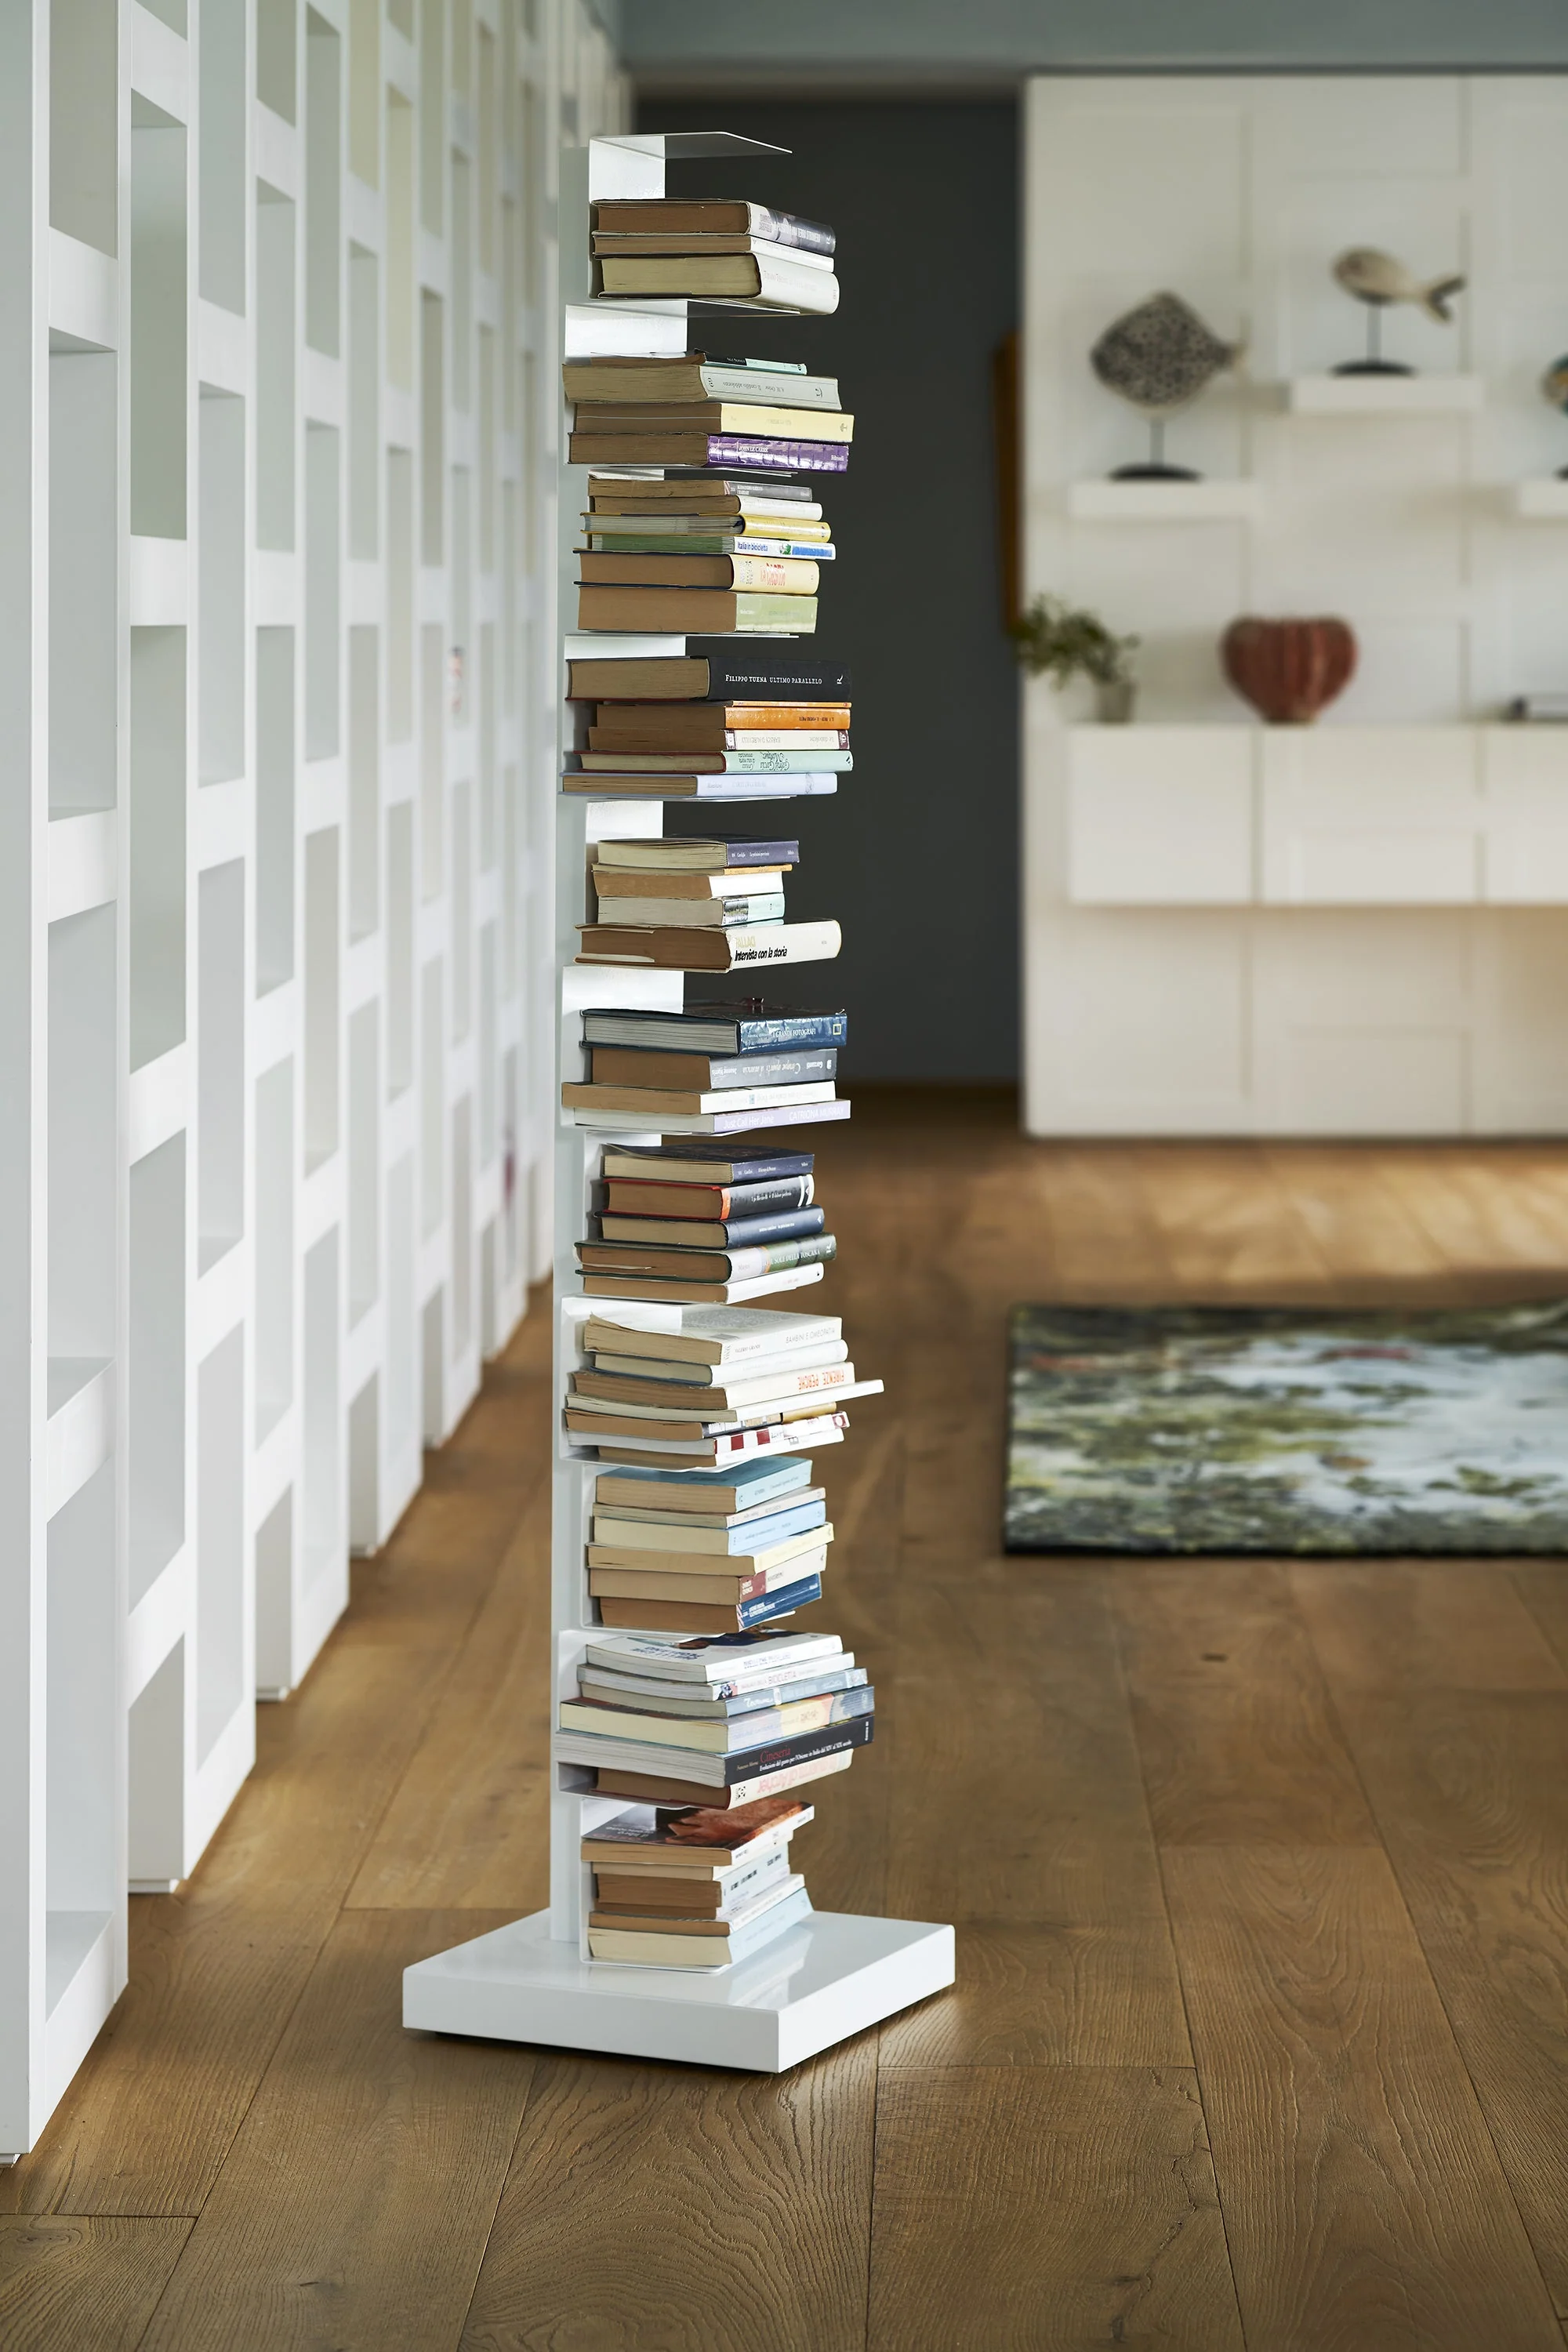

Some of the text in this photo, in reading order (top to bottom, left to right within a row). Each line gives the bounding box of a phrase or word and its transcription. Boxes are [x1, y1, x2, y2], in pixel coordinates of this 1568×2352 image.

[737, 542, 747, 550] Italia
[751, 543, 768, 552] bicicletta
[734, 946, 788, 962] Intervista con la storia
[793, 1028, 816, 1036] FOTOGRAFI
[789, 1105, 844, 1121] CATRIONA MURRAY
[723, 1115, 775, 1130] Just Call Her Jane
[786, 1334, 804, 1344] BAMBINI
[768, 1670, 797, 1686] BICICLETTA
[760, 1747, 791, 1764] Cineseria
